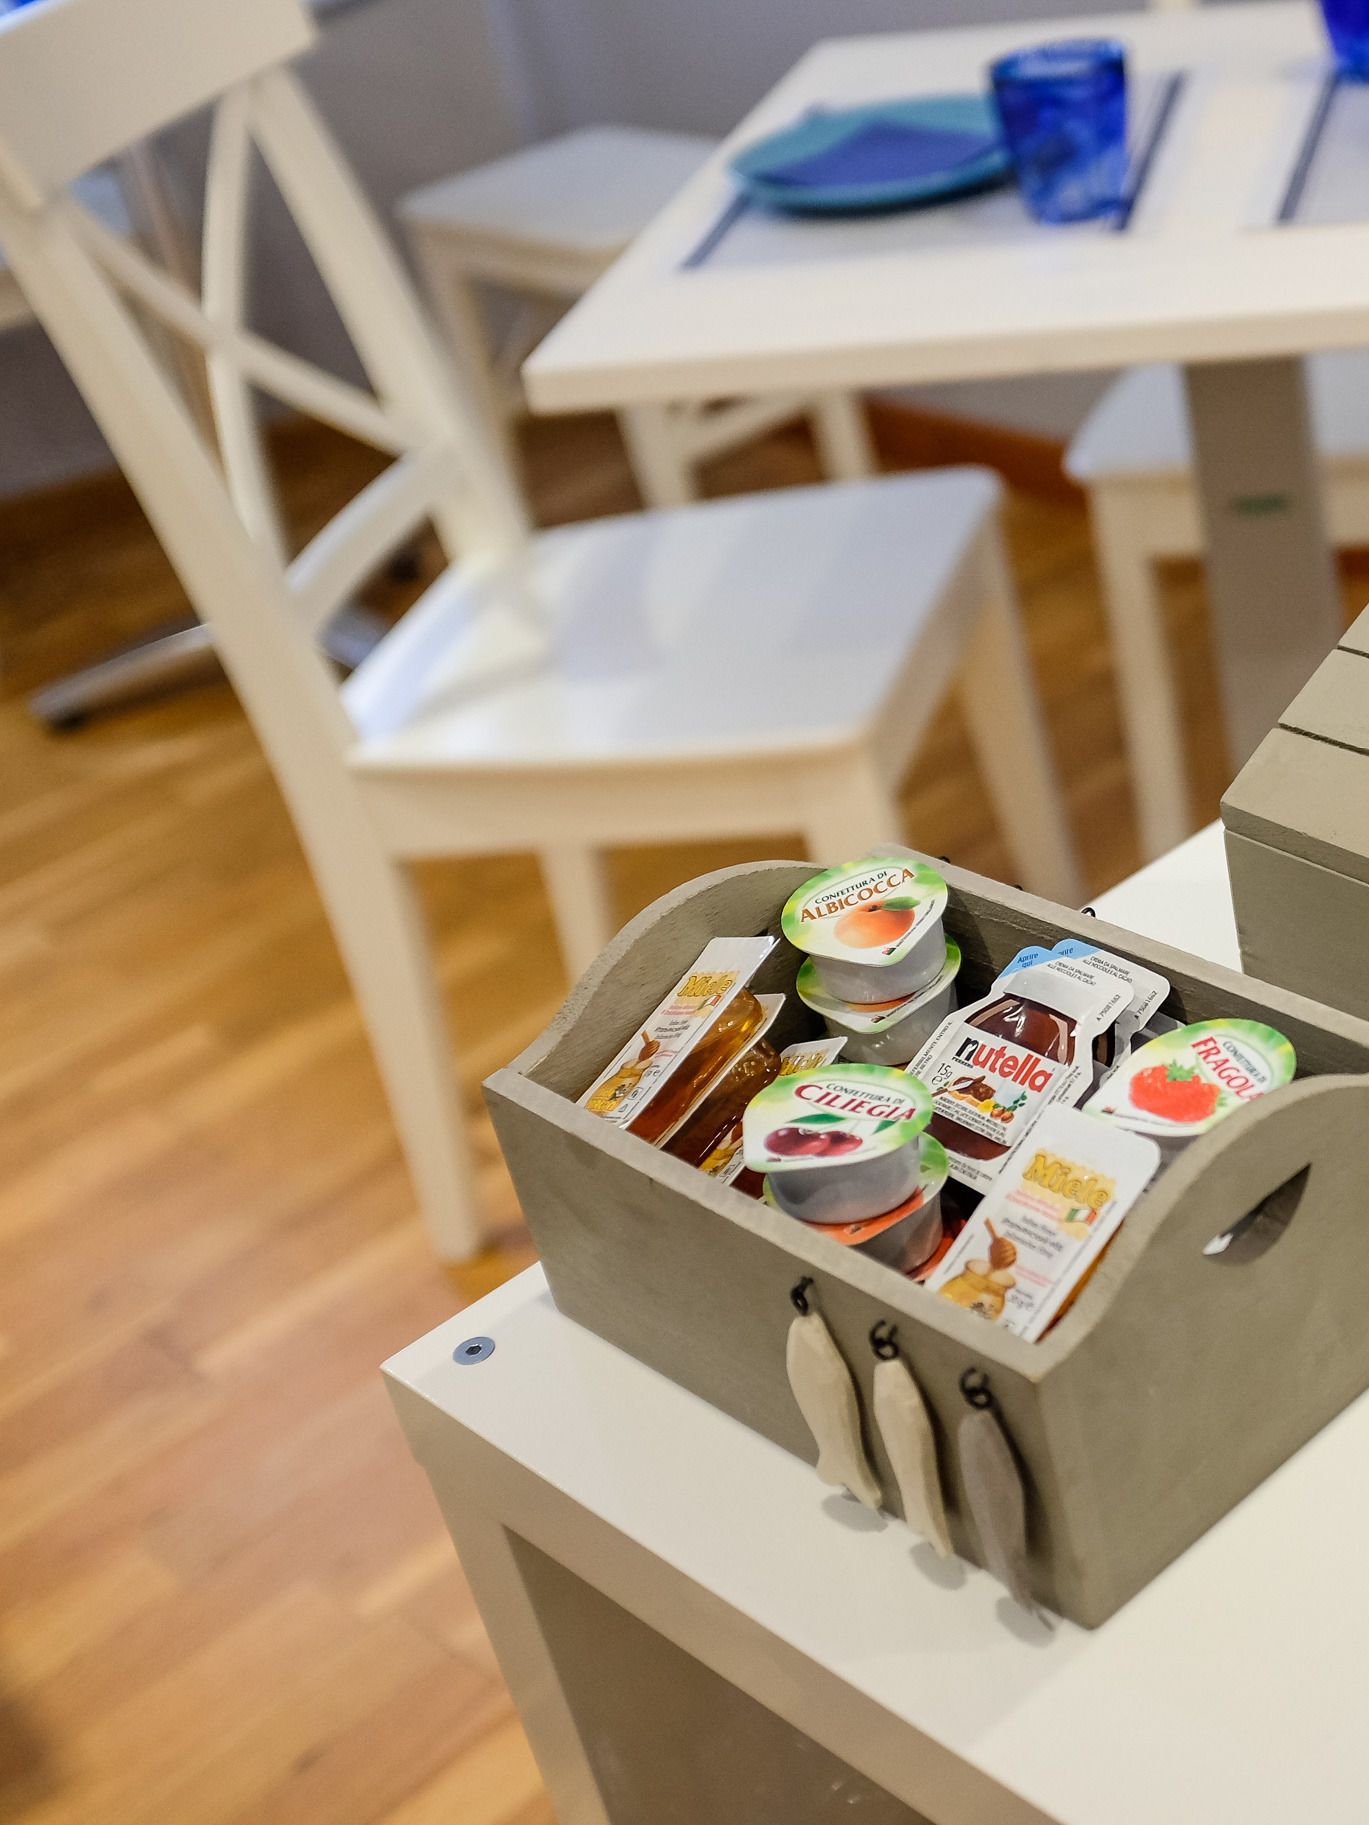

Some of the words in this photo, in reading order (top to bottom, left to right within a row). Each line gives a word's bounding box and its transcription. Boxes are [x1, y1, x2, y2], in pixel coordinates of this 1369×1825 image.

[800, 868, 915, 923] ALBICOCCA
[815, 877, 876, 904] CONFETTURA
[877, 871, 888, 880] DI
[1017, 952, 1039, 964] Aprire
[1021, 960, 1033, 969] qui
[677, 975, 733, 997] Miele
[955, 1036, 1053, 1093] nutella
[794, 1083, 917, 1121] CILIEGIA
[826, 1083, 891, 1103] CONFETTURA
[892, 1097, 904, 1105] DI
[1022, 1153, 1109, 1209] Miele
